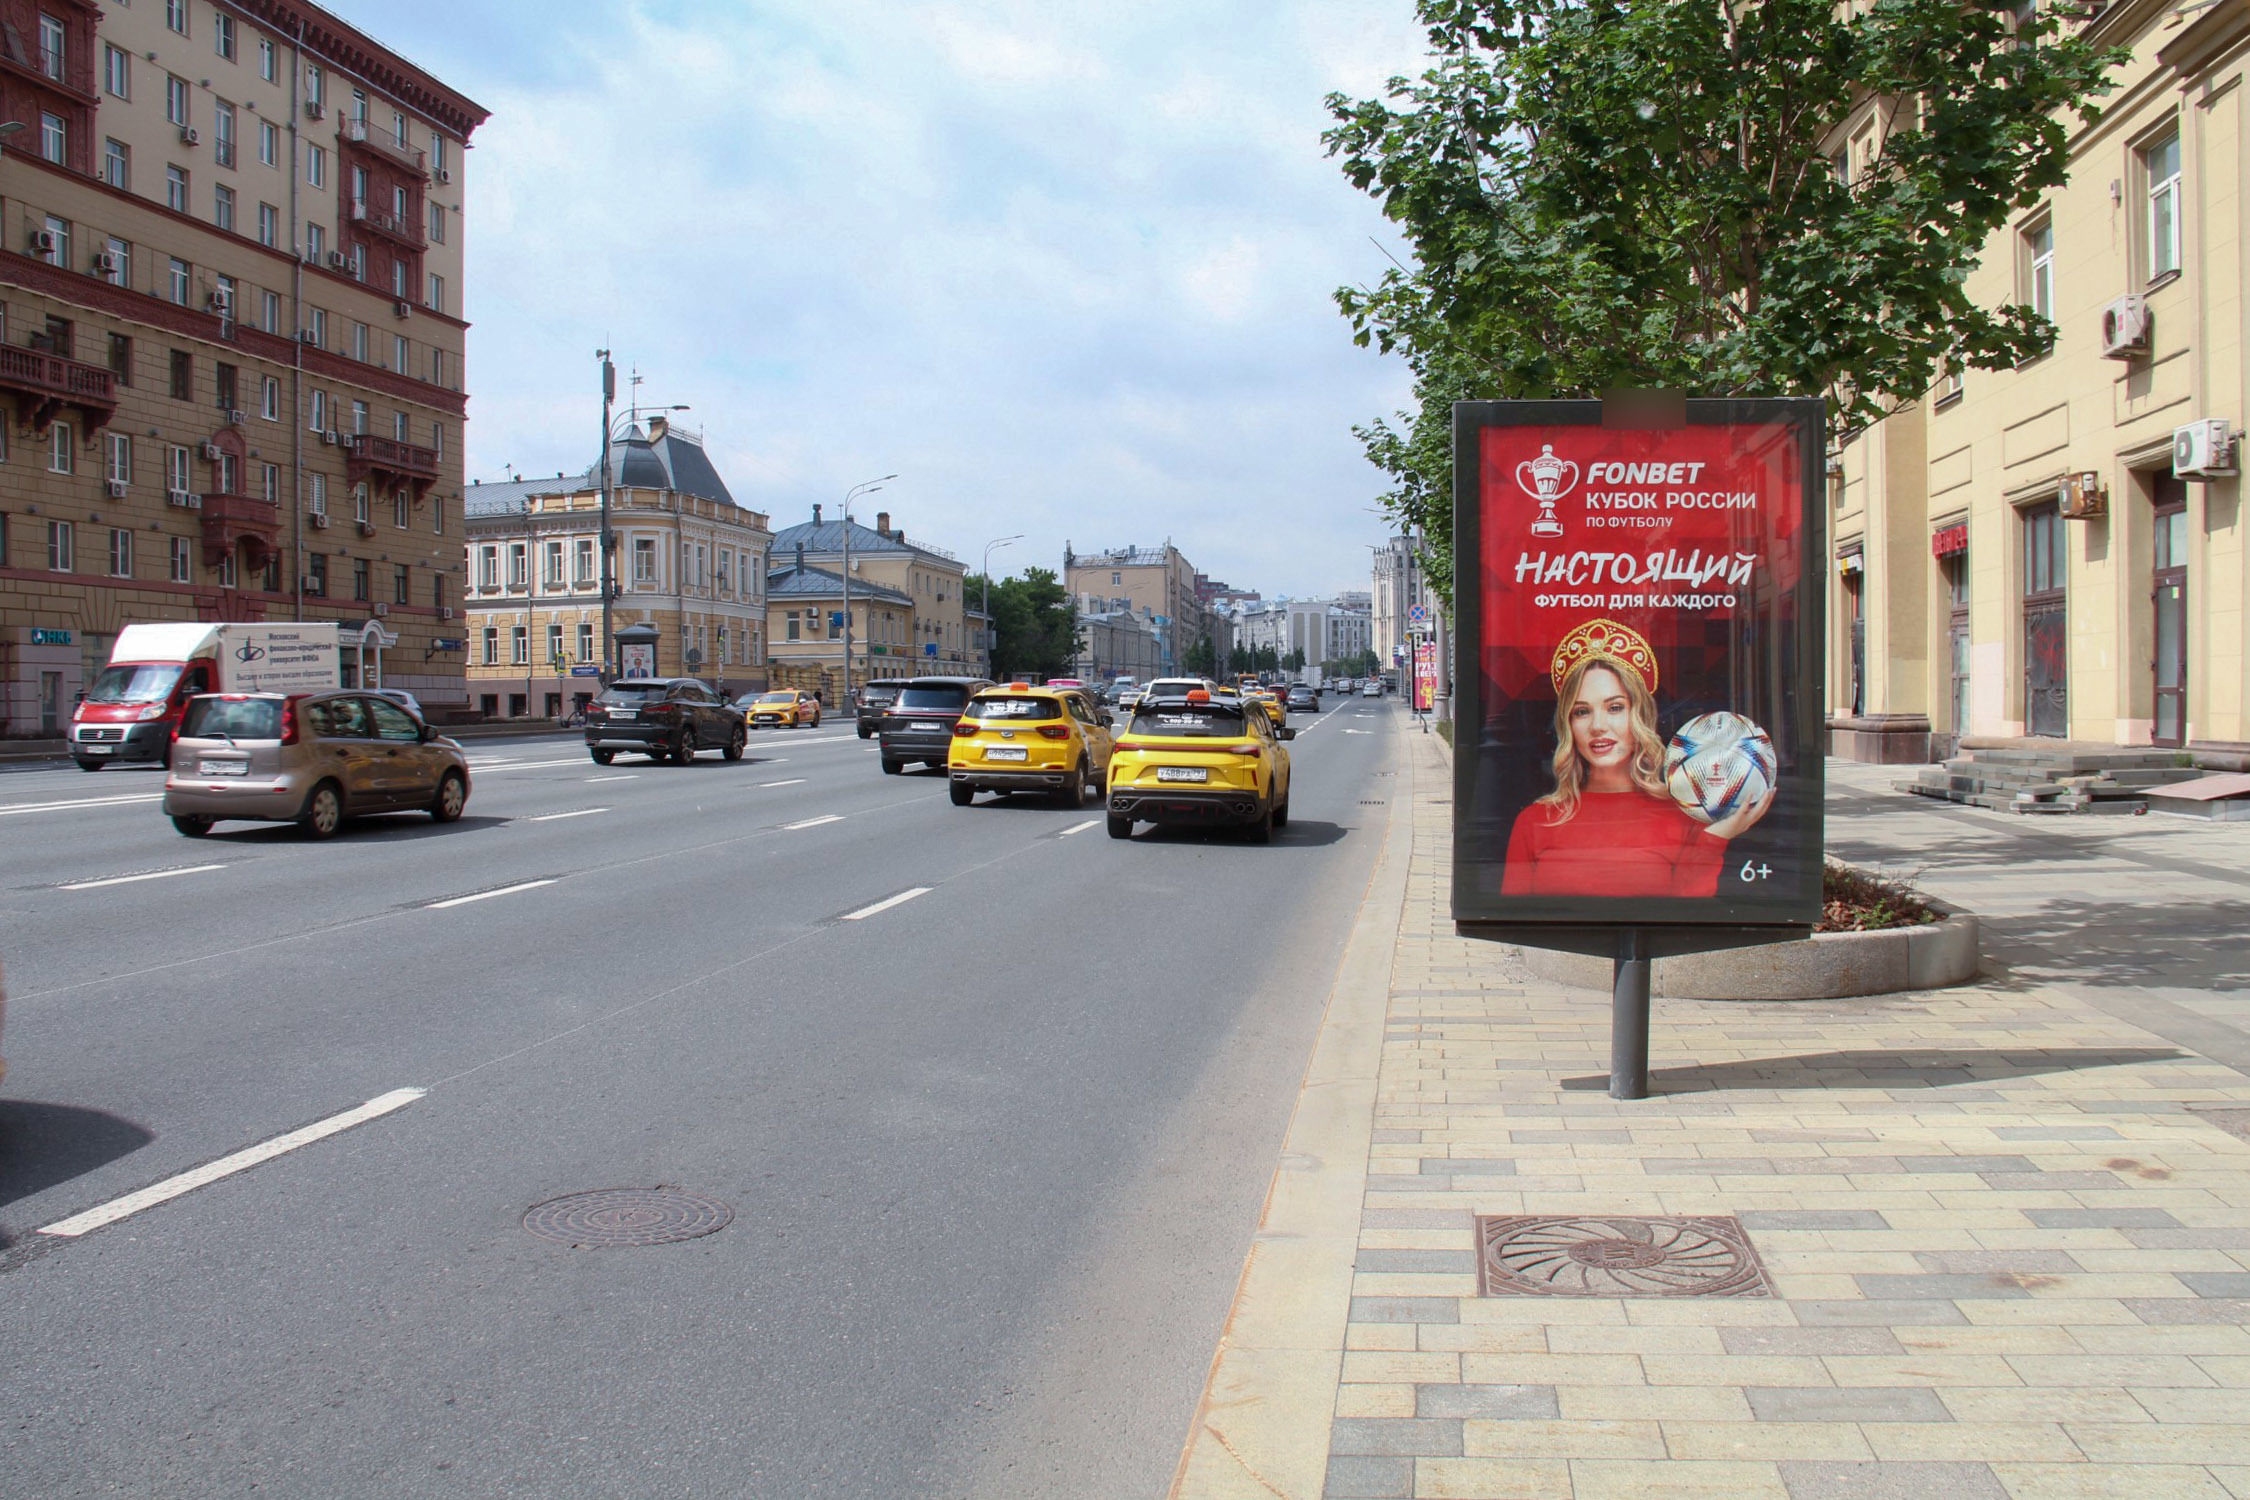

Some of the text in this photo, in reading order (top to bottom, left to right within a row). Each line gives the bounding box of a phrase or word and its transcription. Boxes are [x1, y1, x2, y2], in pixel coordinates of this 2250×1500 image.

[1586, 462, 1705, 485] FONBET
[1586, 491, 1757, 509] КУБОК РОССИИ
[1586, 516, 1674, 528] ПО ФУТБОЛУ
[1514, 548, 1757, 589] НАСТОЯЩИЙ
[1534, 594, 1737, 610] ФУТБОЛ ДЛЯ КАЖДОГО
[1740, 859, 1773, 882] 6+
